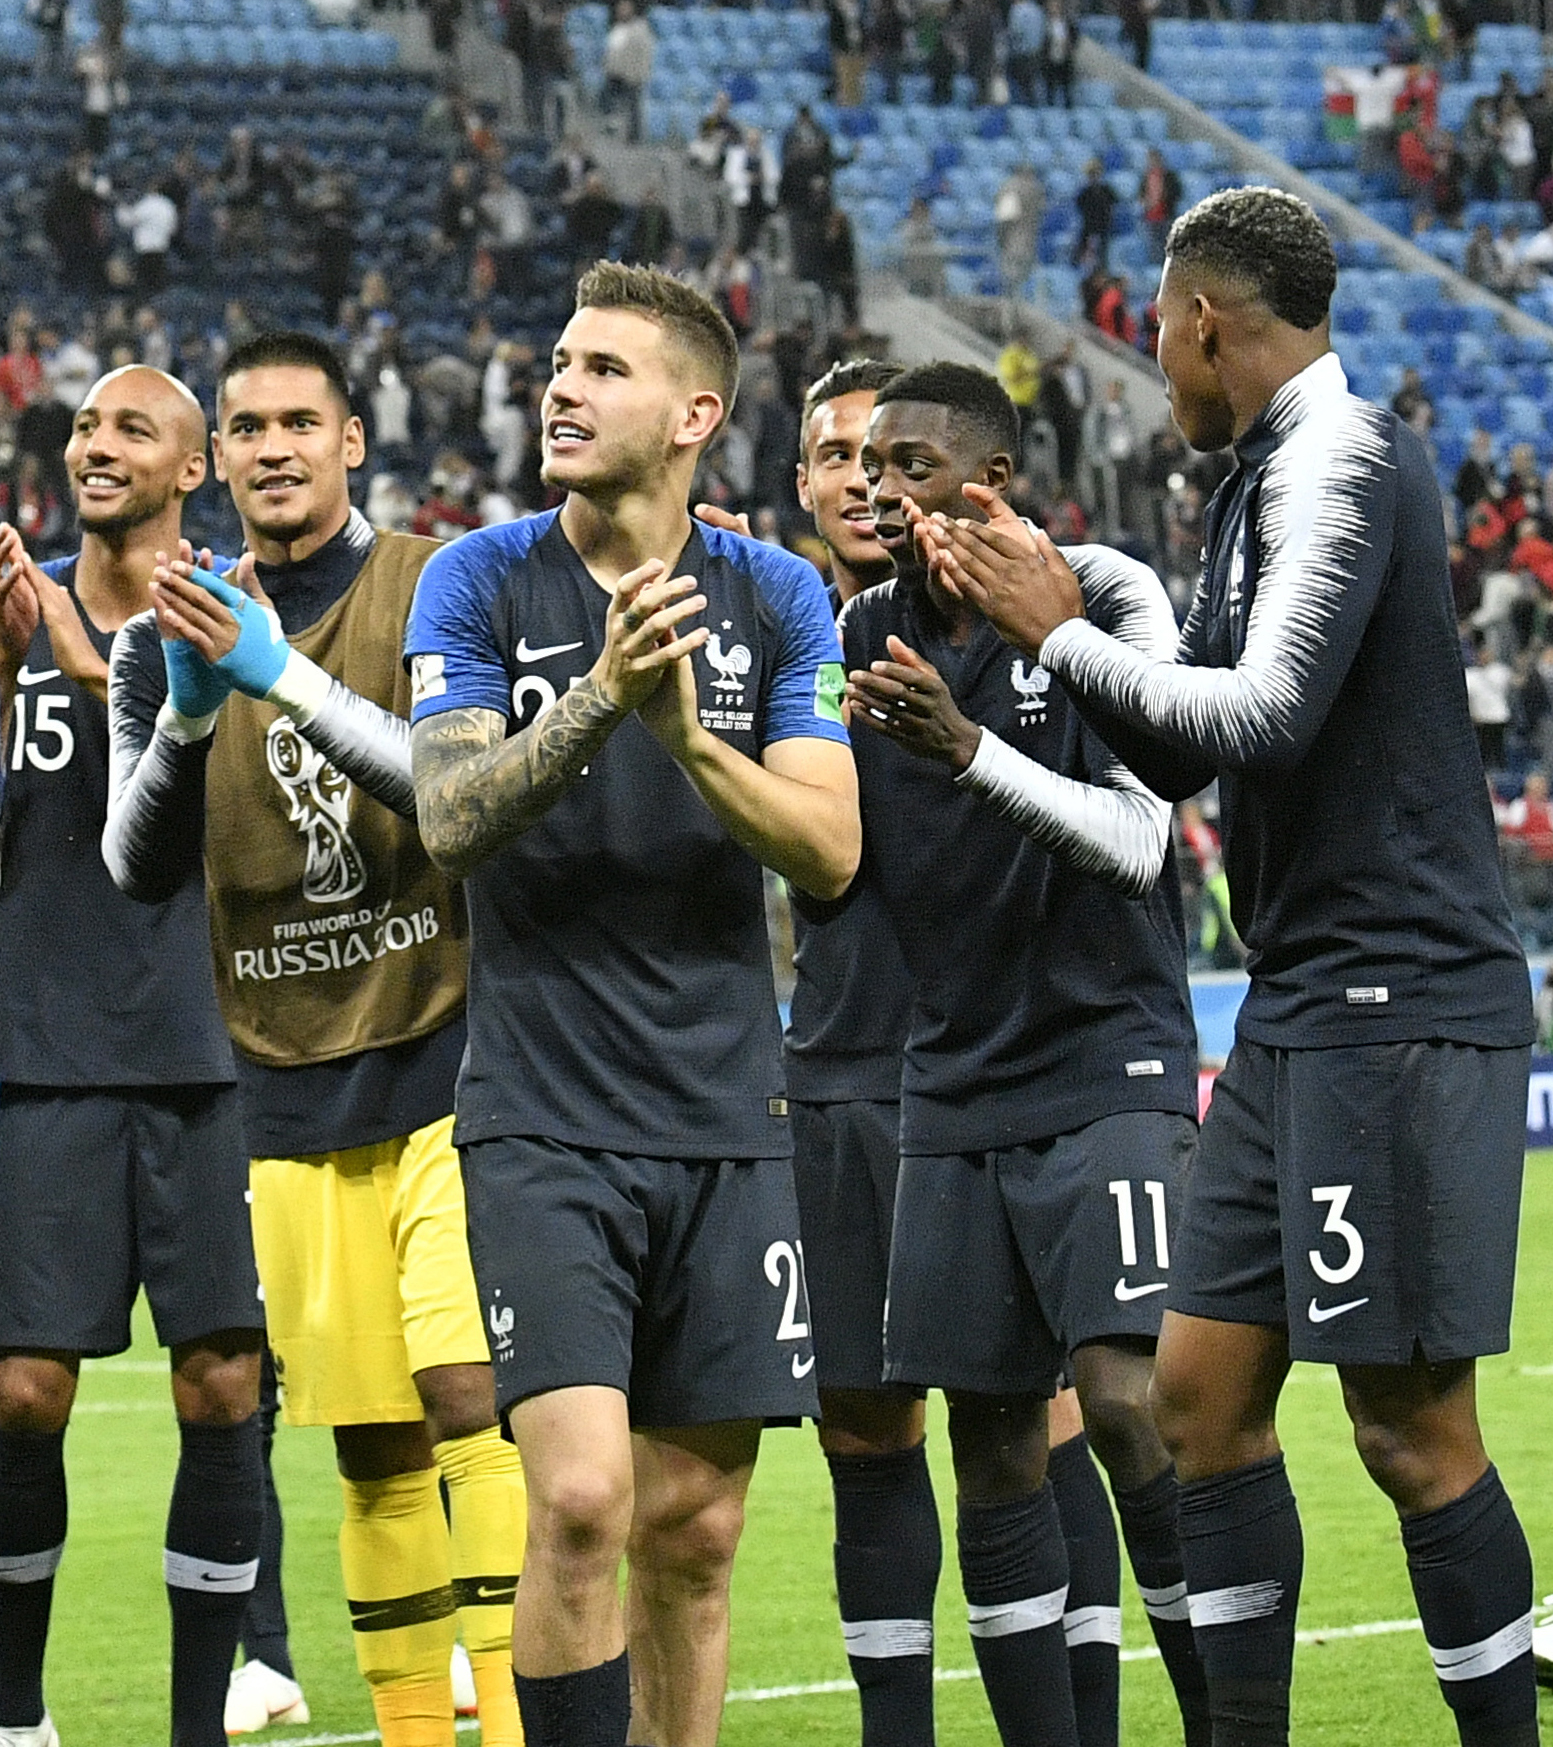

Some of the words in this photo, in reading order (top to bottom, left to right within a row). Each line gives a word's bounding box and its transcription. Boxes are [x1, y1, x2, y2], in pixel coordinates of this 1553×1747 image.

[11, 693, 75, 772] 15
[234, 932, 373, 981] RUSSIA
[374, 906, 439, 959] 2018
[273, 922, 310, 940] FIFA
[308, 909, 373, 935] WORLD
[1109, 1180, 1169, 1269] 11
[1309, 1185, 1364, 1284] 3
[763, 1239, 812, 1341] 2
